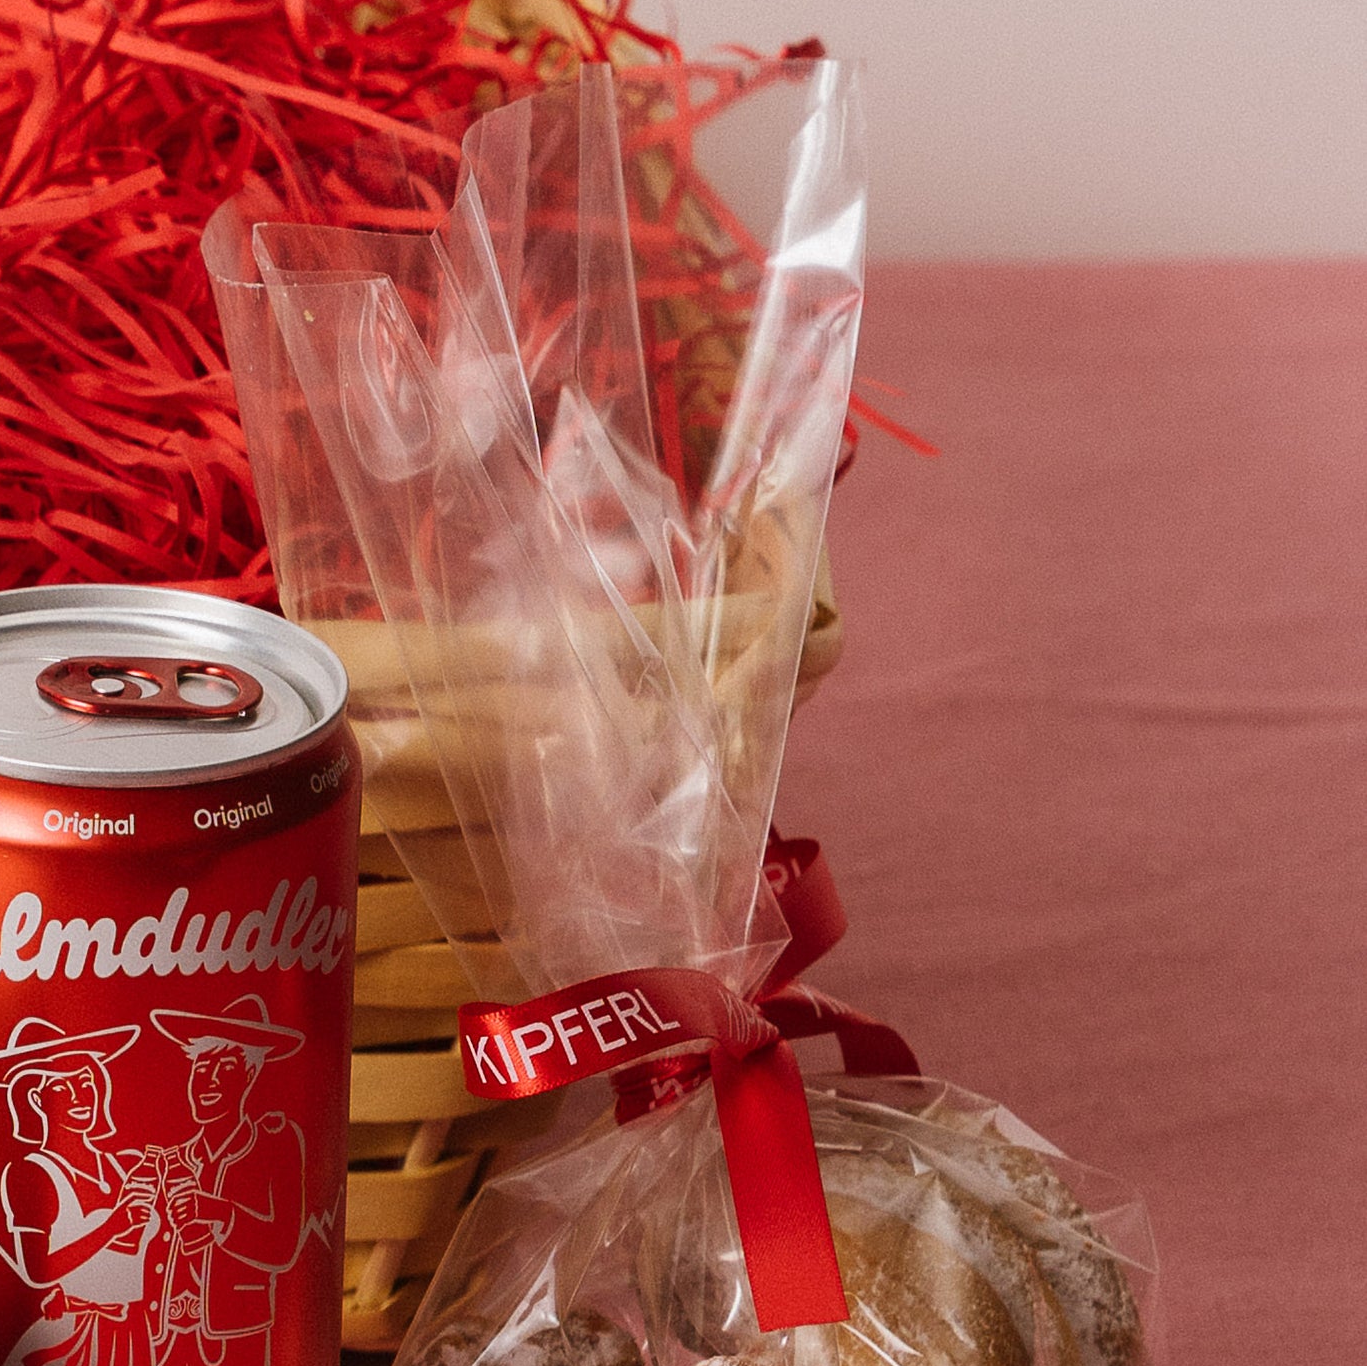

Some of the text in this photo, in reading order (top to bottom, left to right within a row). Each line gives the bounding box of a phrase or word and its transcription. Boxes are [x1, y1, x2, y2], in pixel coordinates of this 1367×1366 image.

[309, 750, 353, 795] Original
[42, 809, 136, 841] Original
[193, 794, 274, 833] Original
[465, 987, 681, 1086] KIPFERL
